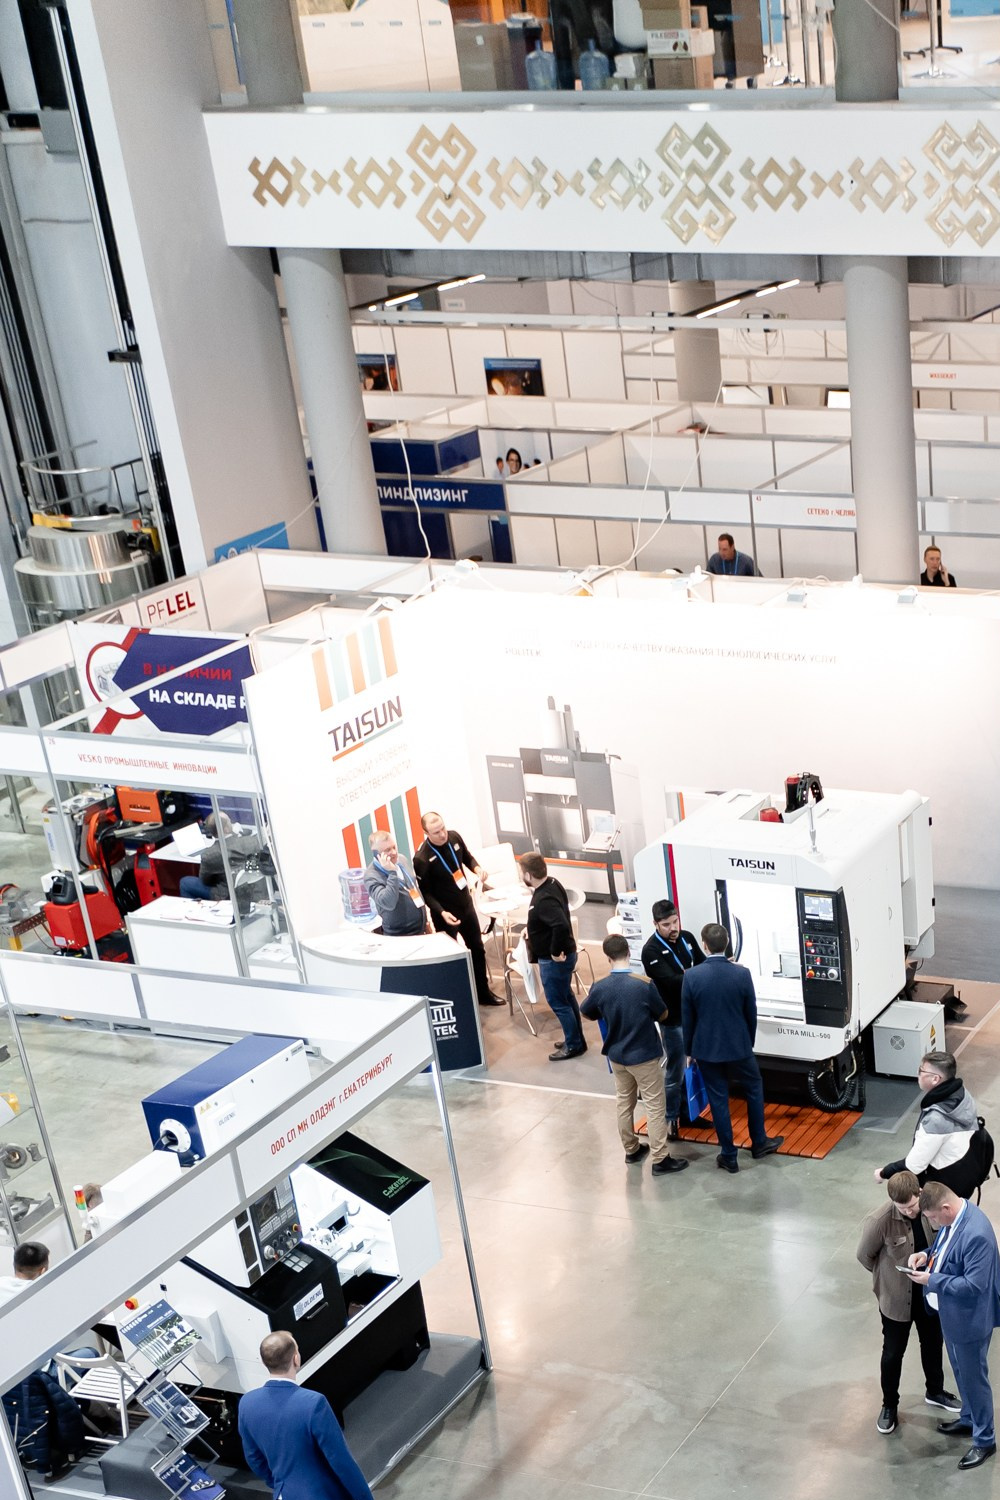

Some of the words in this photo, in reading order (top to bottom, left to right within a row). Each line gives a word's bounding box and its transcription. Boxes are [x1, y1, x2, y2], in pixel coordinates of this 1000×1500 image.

[143, 662, 153, 676] В
[149, 688, 172, 705] НА
[173, 690, 237, 710] СКЛАДЕ
[327, 695, 403, 752] TAISUN
[78, 753, 103, 765] VESKO
[104, 755, 170, 771] ПРОМЫШЛЕННЫЕ
[172, 761, 218, 775] ИННОВАЦИИ
[728, 857, 776, 871] TAISUN
[777, 1027, 800, 1037] ULTRA
[270, 1136, 286, 1156] ООО
[287, 1128, 296, 1143] СП
[310, 1096, 337, 1126] ОЛДЭНГ
